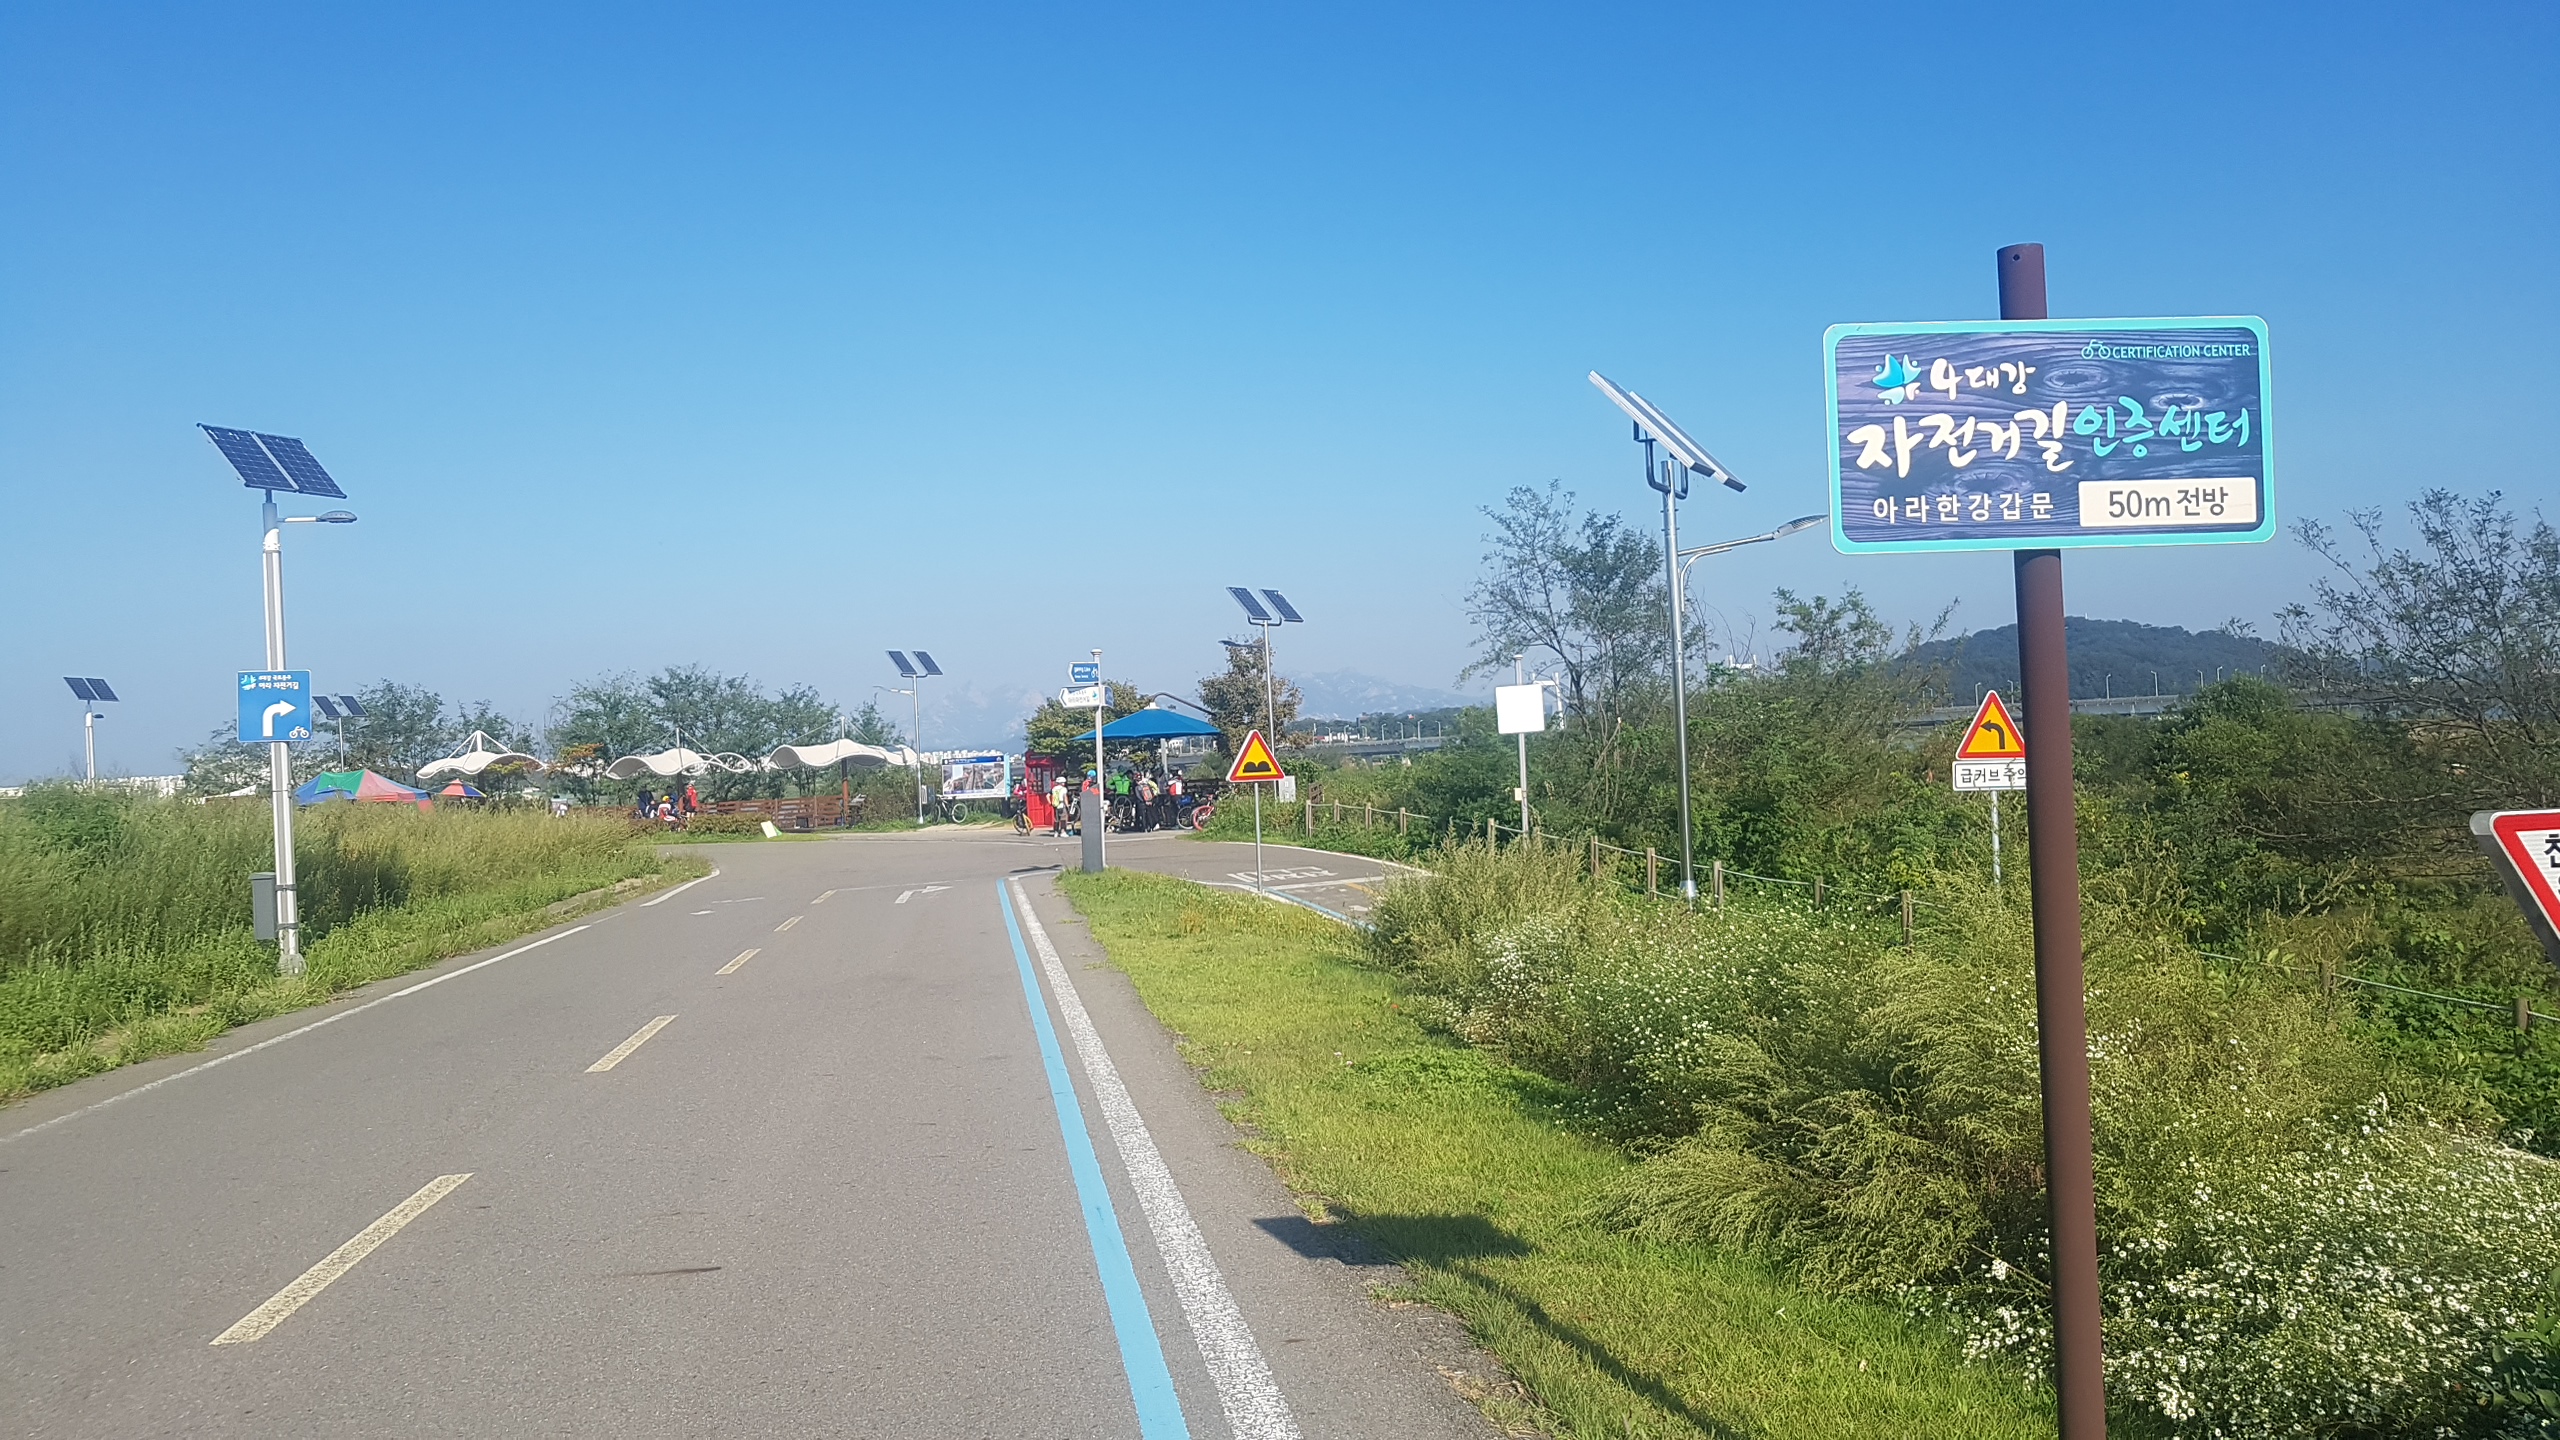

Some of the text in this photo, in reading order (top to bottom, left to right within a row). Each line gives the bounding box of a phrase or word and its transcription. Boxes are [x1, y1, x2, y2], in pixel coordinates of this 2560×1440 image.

[2111, 342, 2251, 360] CERTIFICATION CENTER
[1930, 358, 2037, 400] 4대강
[2108, 486, 2229, 519] 50m 전방
